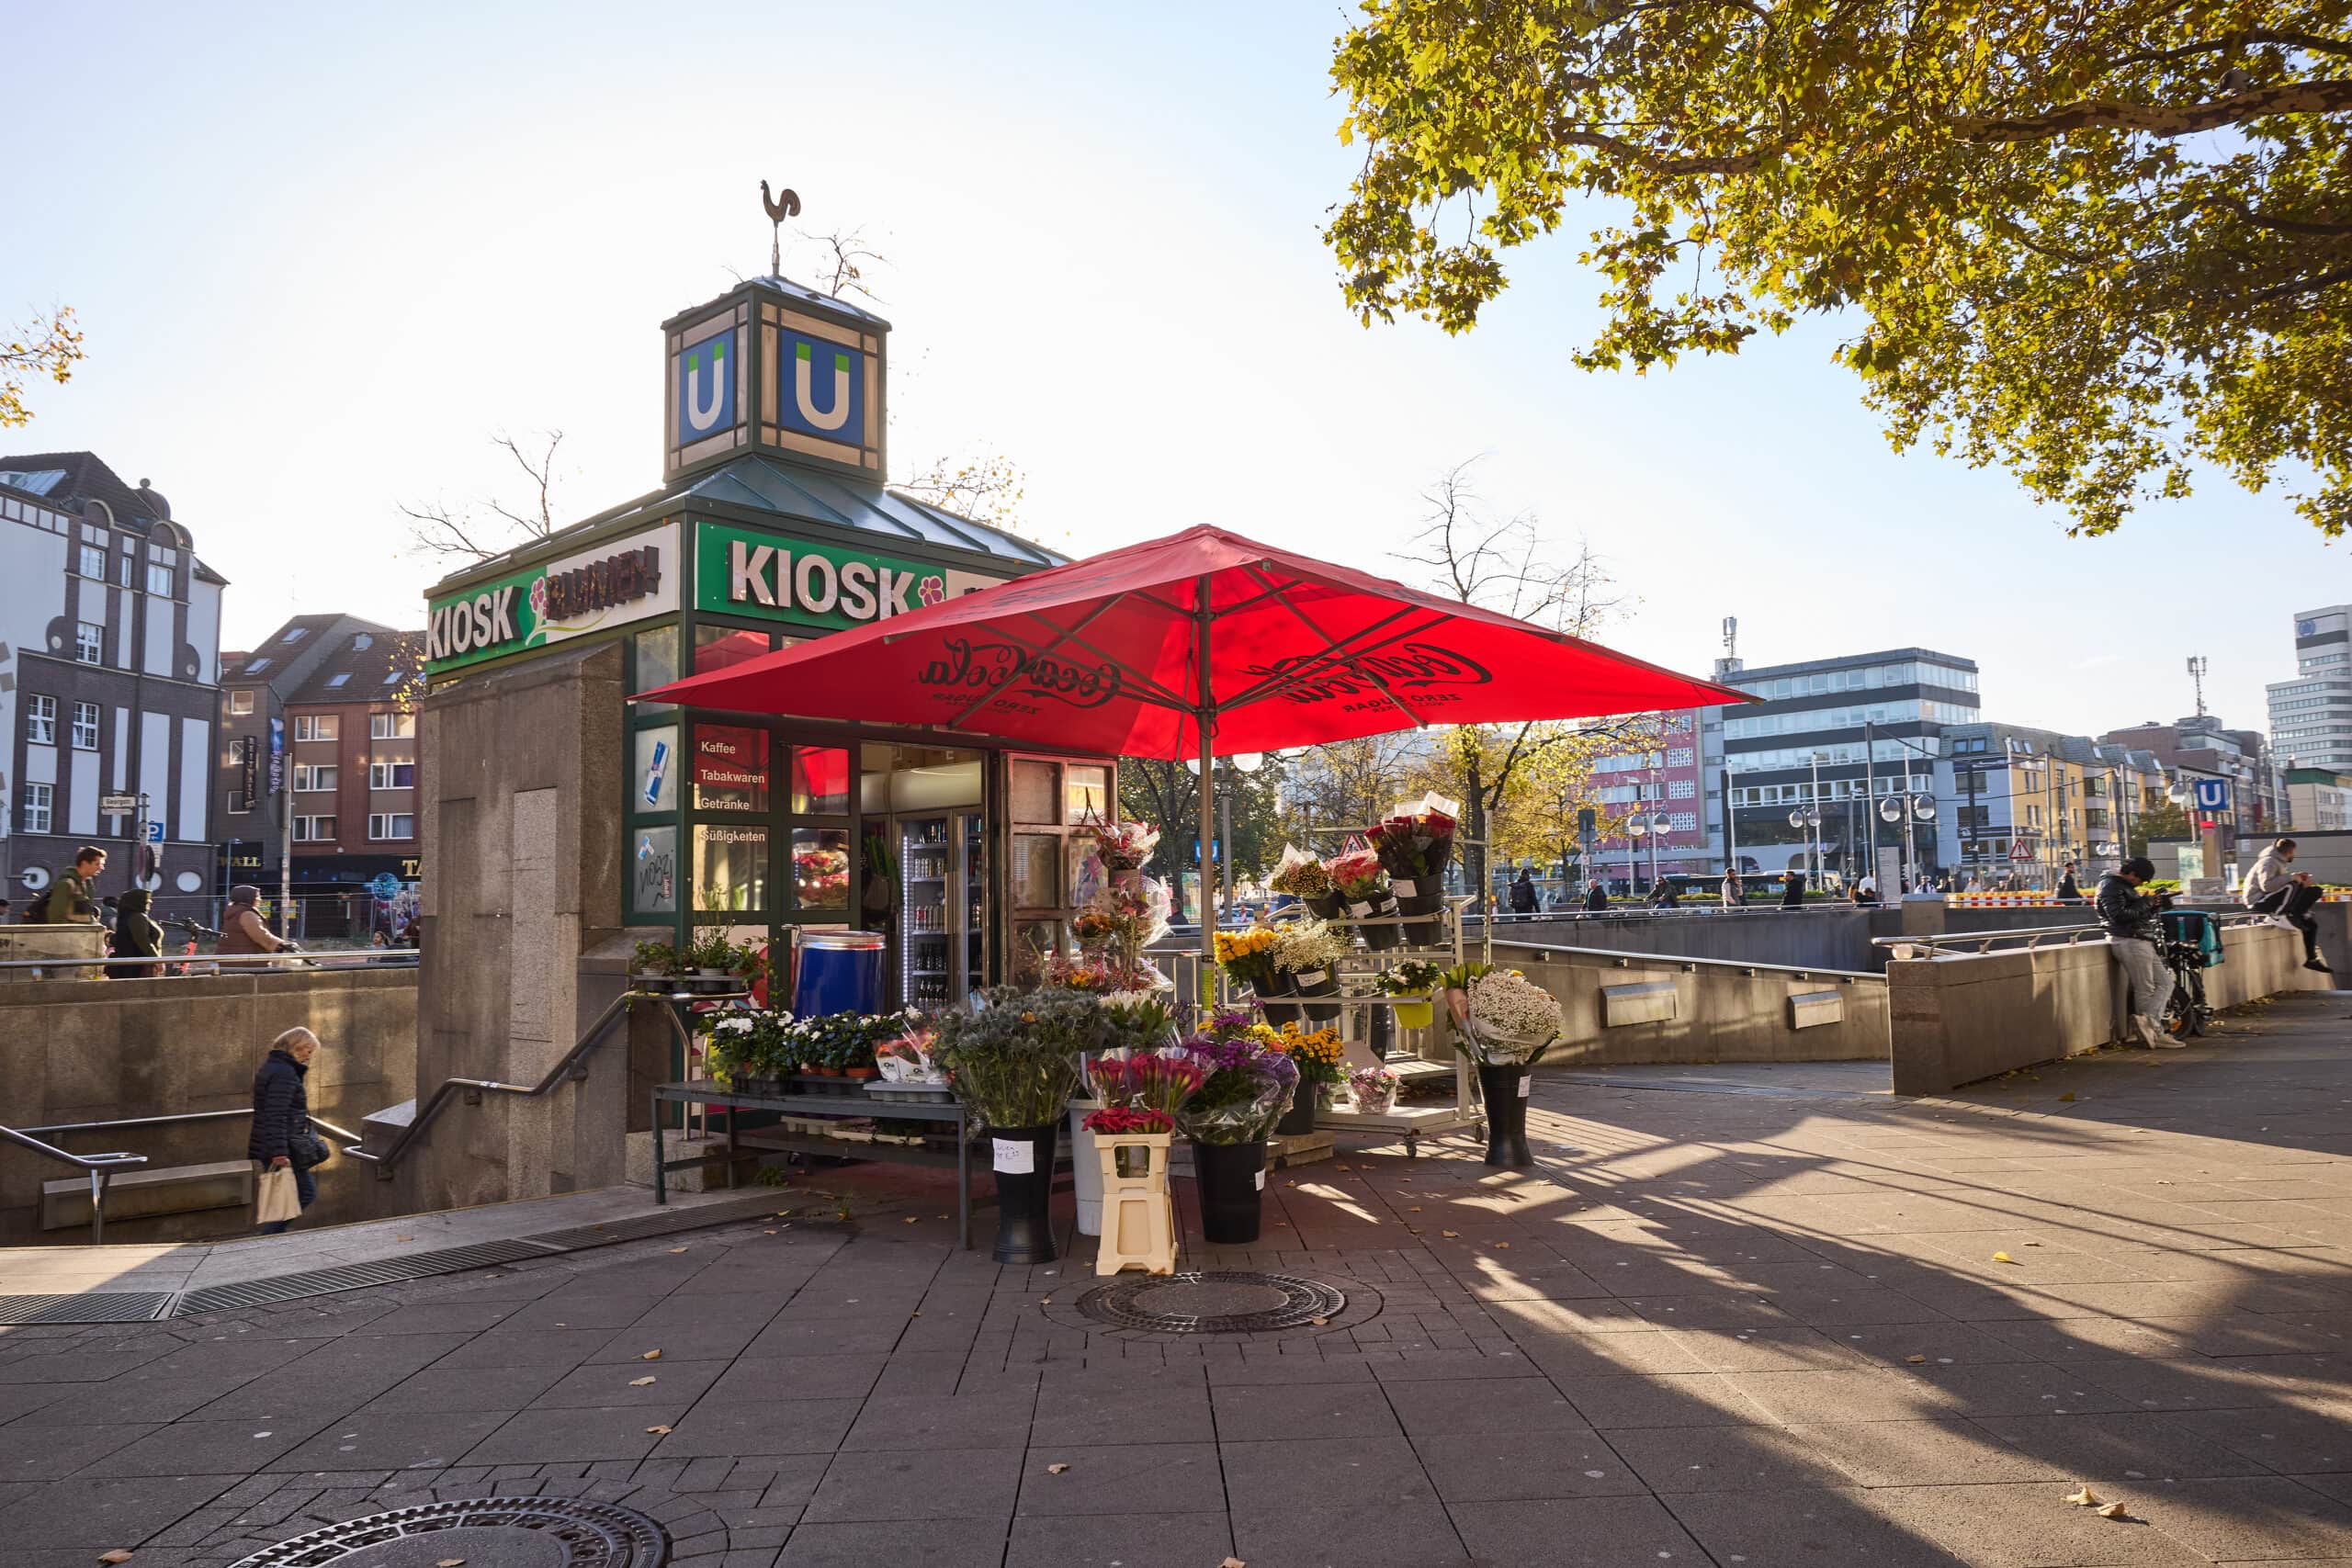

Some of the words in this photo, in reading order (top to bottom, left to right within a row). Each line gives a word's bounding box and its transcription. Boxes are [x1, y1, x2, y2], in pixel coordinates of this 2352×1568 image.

[688, 341, 724, 430] U
[796, 341, 850, 431] U
[732, 539, 916, 622] KIOSK
[425, 585, 514, 661] KIOSK
[701, 741, 736, 754] Kaffee
[700, 769, 765, 784] Tabakwaren
[700, 797, 750, 810] Getränke
[2199, 784, 2222, 806] U
[700, 829, 765, 844] Süßigkeiten
